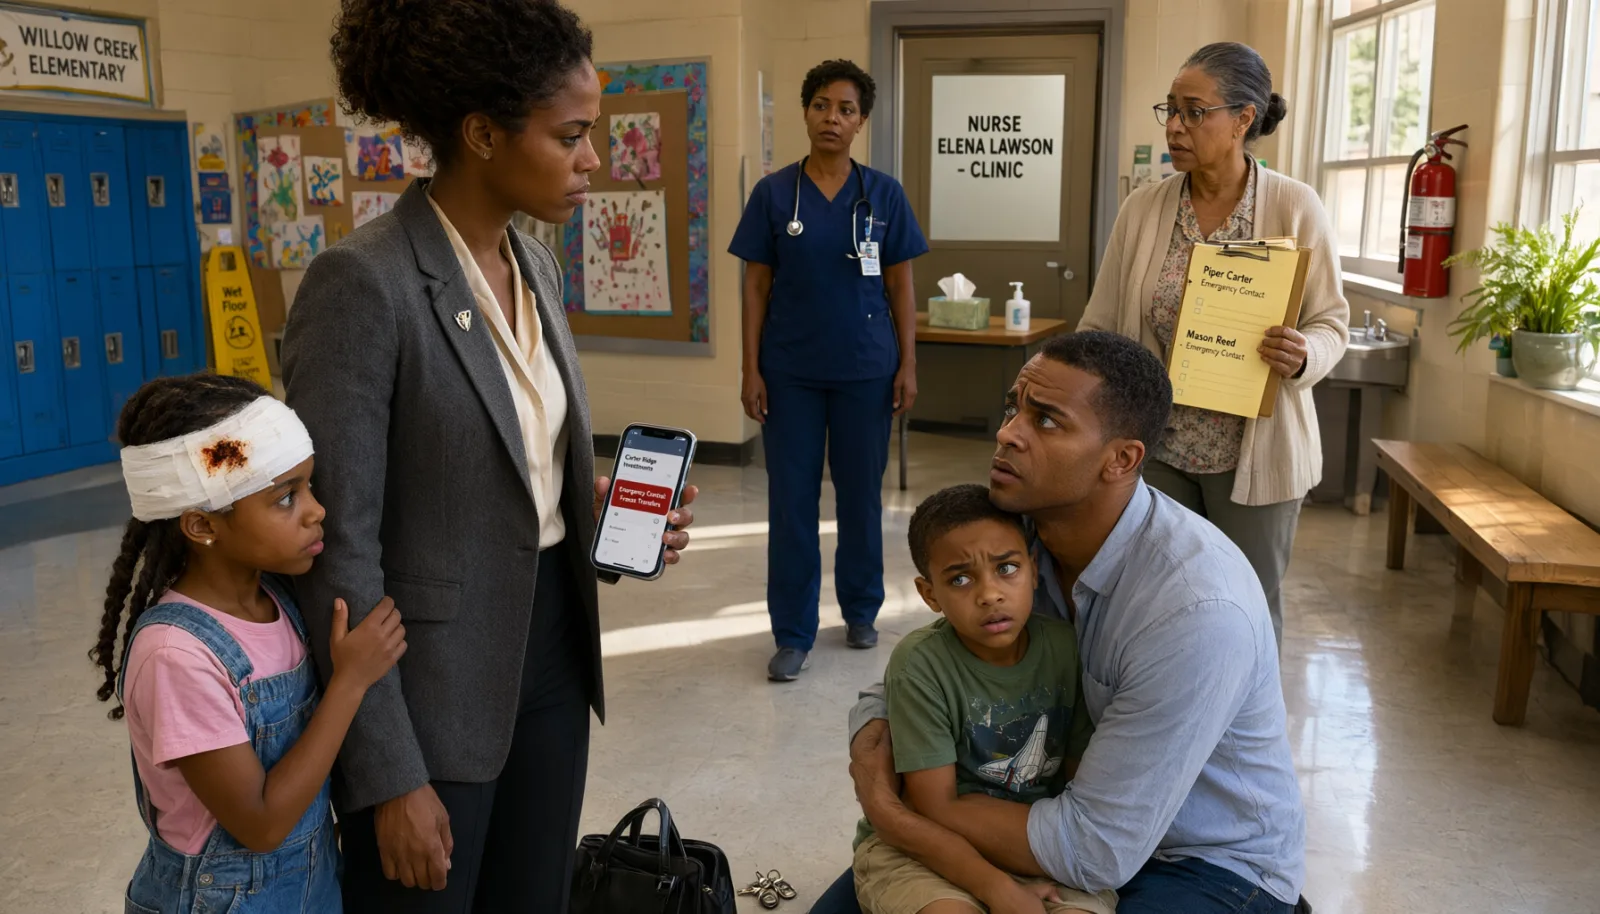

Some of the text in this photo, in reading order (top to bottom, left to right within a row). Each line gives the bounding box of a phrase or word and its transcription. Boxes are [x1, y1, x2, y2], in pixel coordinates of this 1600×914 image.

[18, 25, 139, 61] WILLOW CREEK
[29, 54, 126, 83] ELEMENTARY
[968, 115, 1022, 132] NURSE
[938, 138, 1053, 155] ELENA LAWSON
[970, 161, 1023, 178] CLINIC
[1203, 265, 1253, 284] Piper Carter
[222, 287, 242, 298] Wet
[1200, 278, 1265, 298] Emergency Contact
[222, 301, 247, 312] Floor
[1186, 329, 1236, 347] Mason Reed
[1186, 342, 1245, 360] Emergency Contact
[623, 462, 653, 471] Investments
[624, 454, 657, 465] Carter Ridge
[618, 486, 645, 497] Emergency
[638, 498, 661, 508] Transfers
